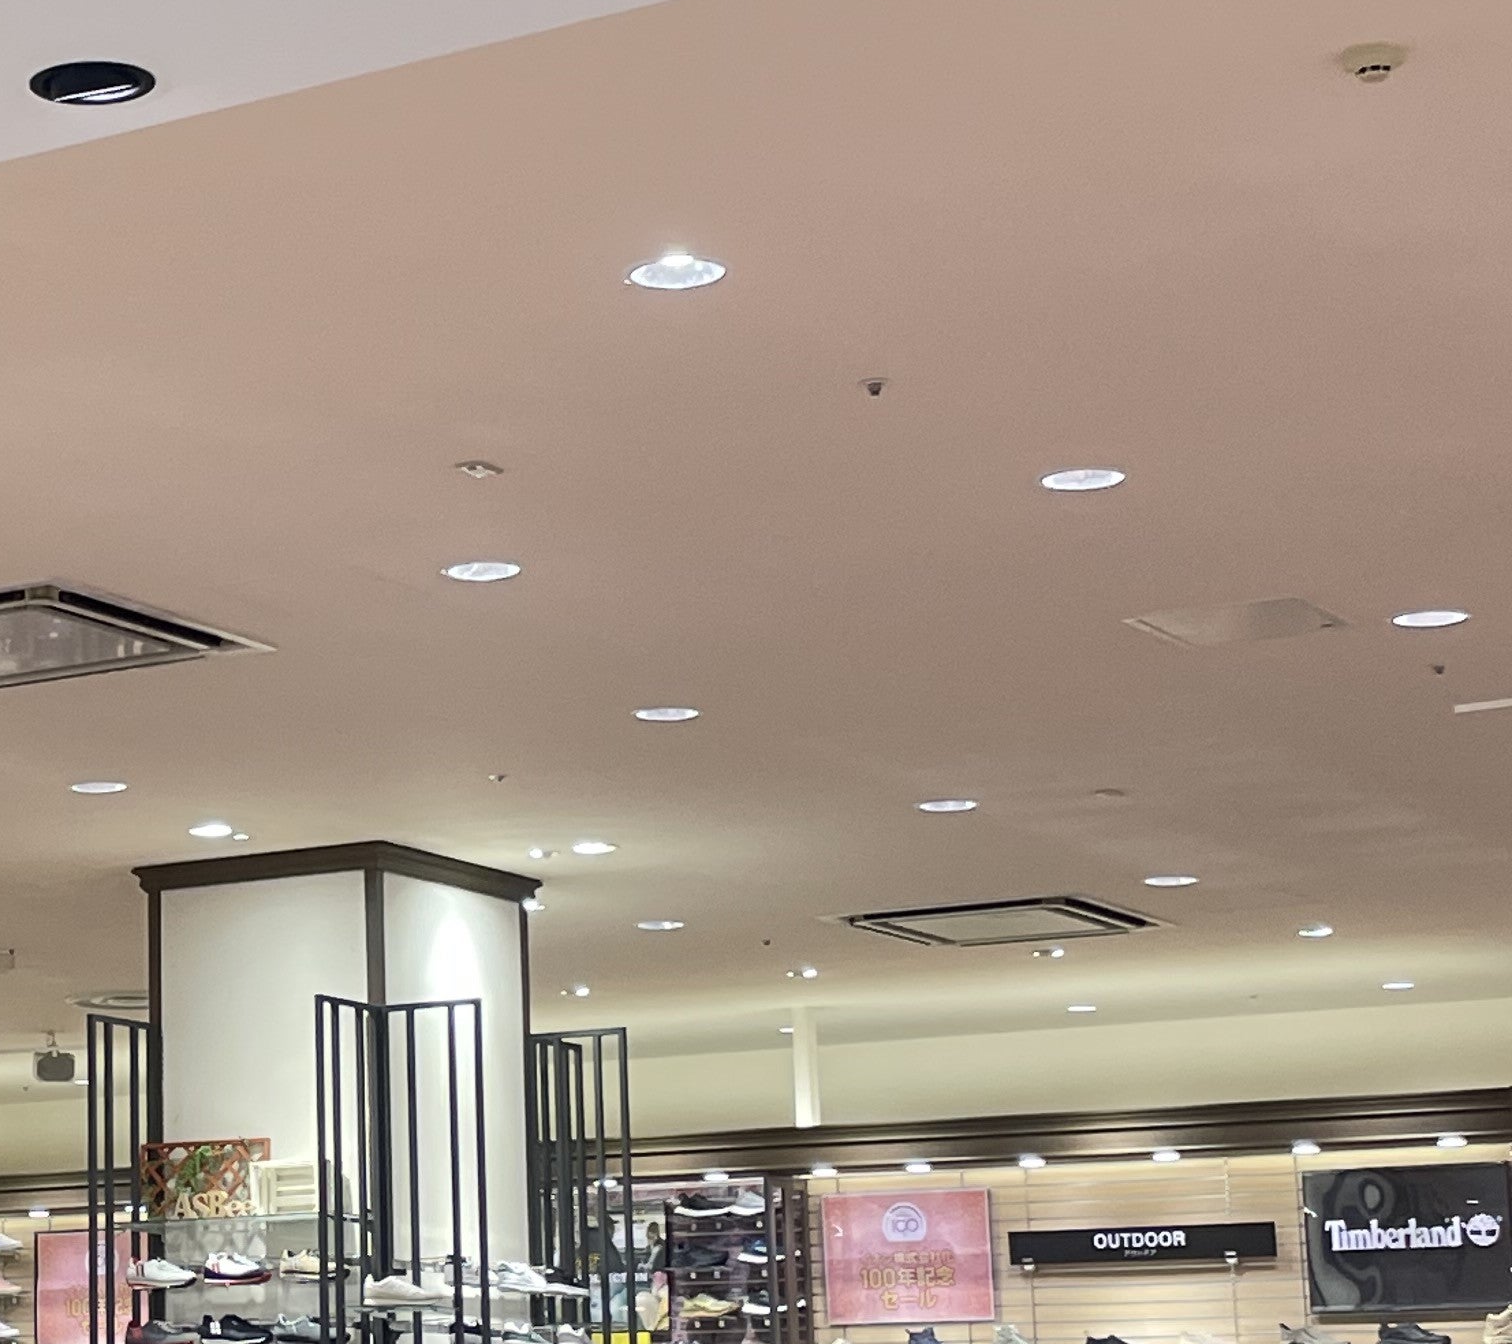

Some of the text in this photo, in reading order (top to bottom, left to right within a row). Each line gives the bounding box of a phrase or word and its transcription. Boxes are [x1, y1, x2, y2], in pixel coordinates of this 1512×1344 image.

[1093, 1230, 1187, 1249] OUTDOOR
[1324, 1215, 1463, 1252] Timberland
[860, 1266, 955, 1289] 100年記念
[881, 1289, 937, 1310] セール
